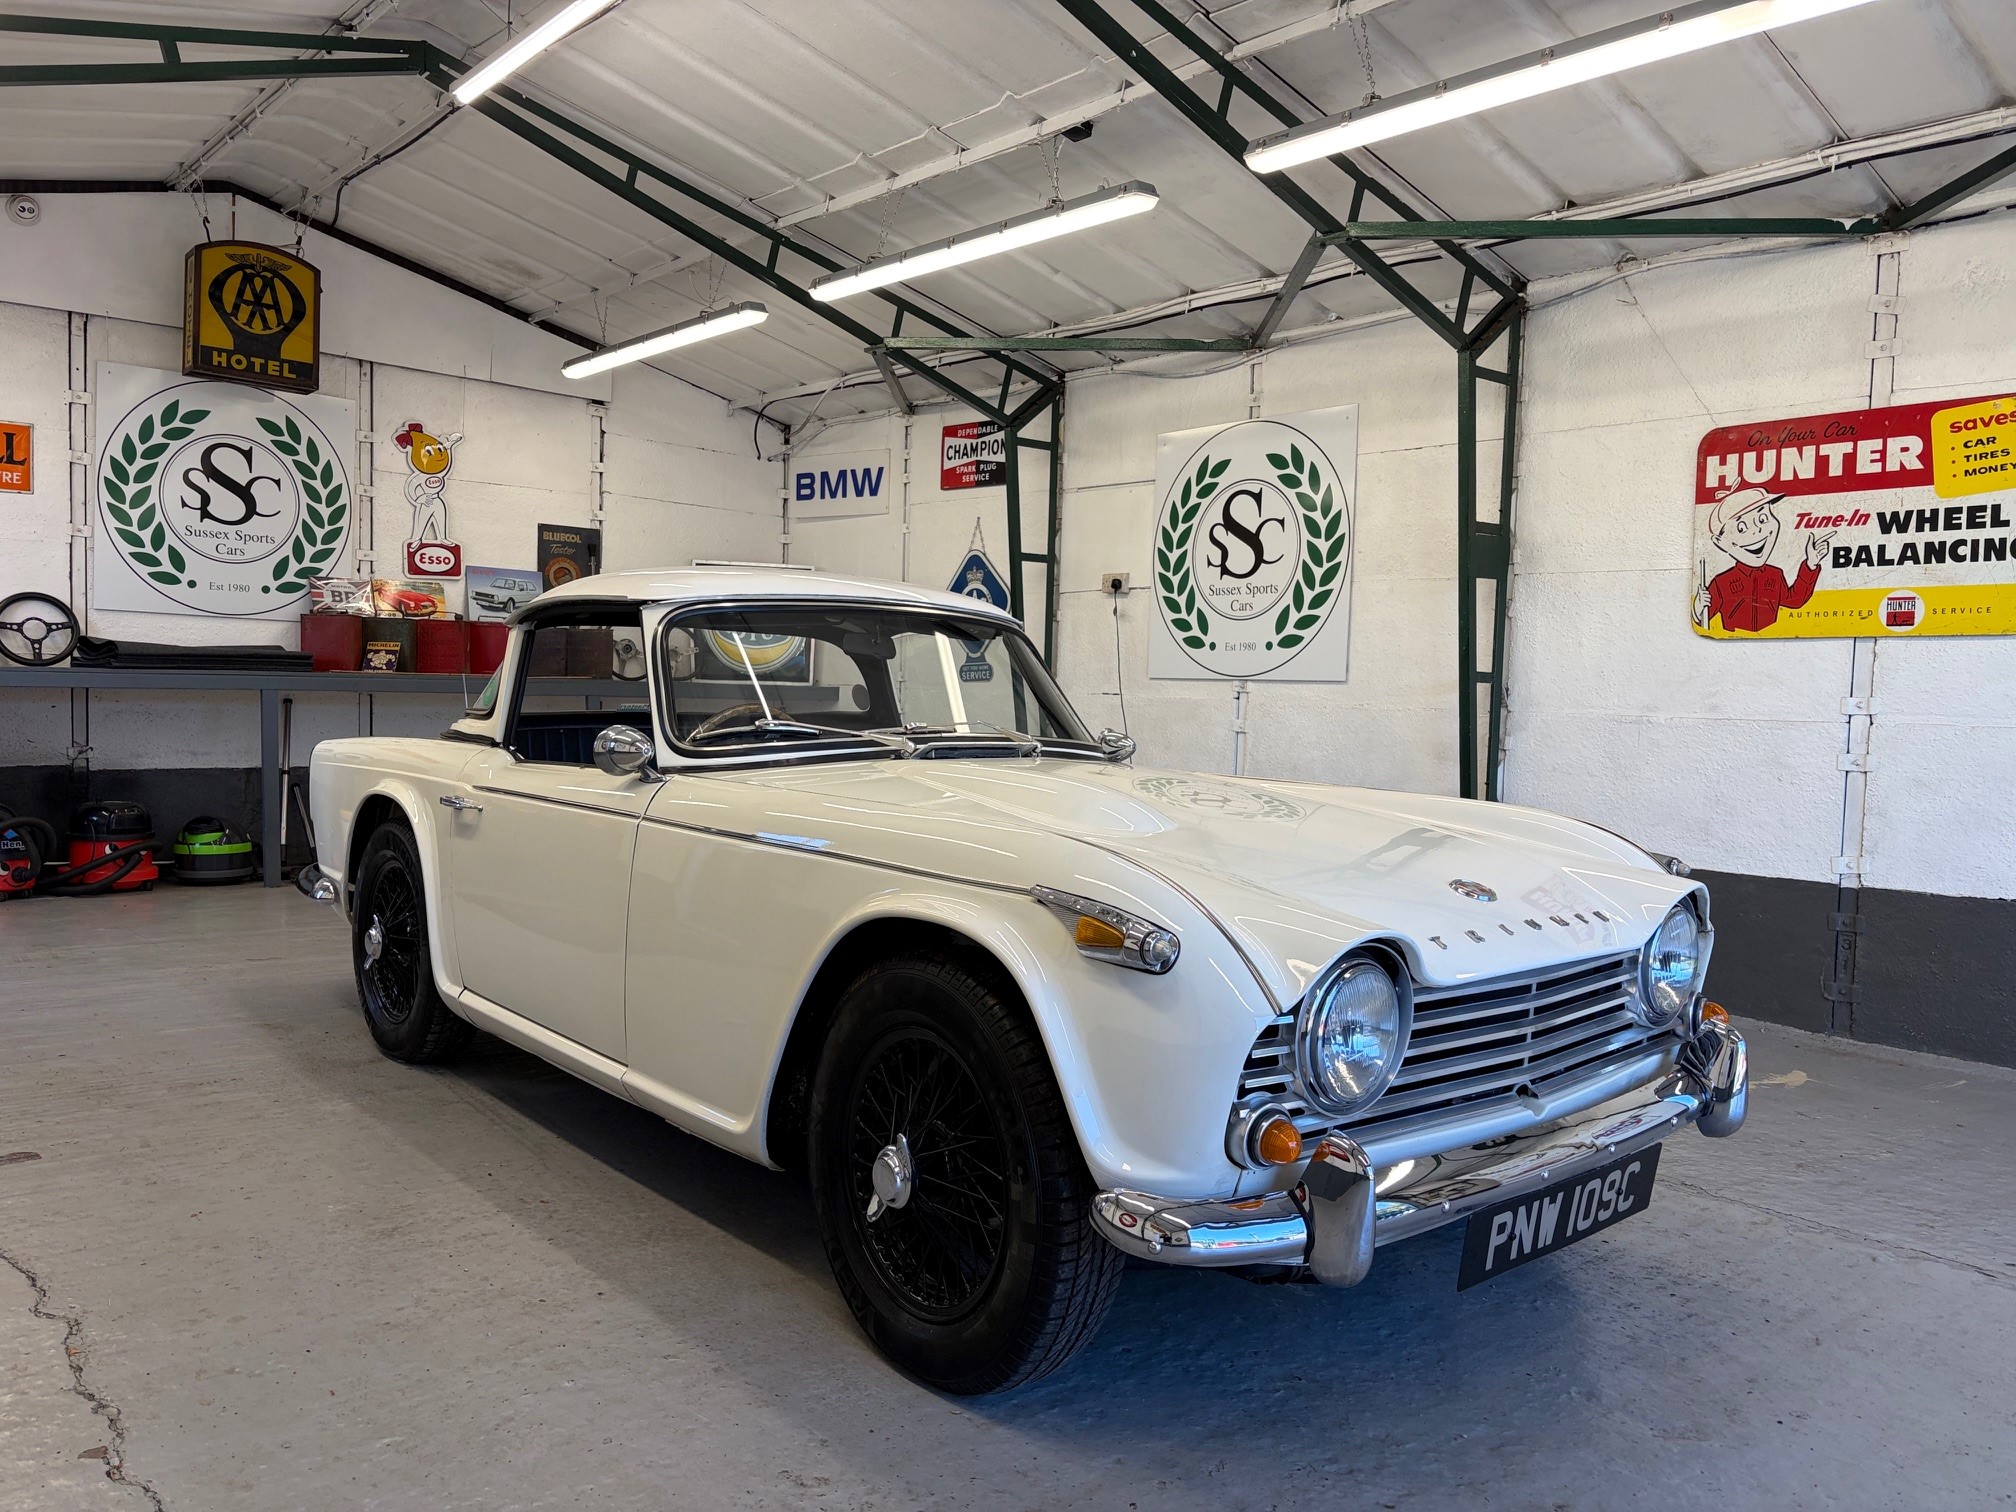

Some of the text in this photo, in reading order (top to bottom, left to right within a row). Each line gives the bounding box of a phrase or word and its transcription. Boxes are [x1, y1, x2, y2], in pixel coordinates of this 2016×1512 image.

[212, 350, 297, 379] HOTEL
[957, 424, 998, 437] DEPENDABLE
[1747, 421, 1858, 448] On Your Car
[1963, 436, 1997, 449] CAR
[1705, 435, 1924, 488] HUNTER
[1964, 448, 2011, 462] TIRES
[955, 462, 997, 474] SPARK PLUG
[1964, 462, 2016, 477] MONEY
[796, 466, 884, 502] BMW
[962, 473, 990, 482] SERVICE
[1793, 503, 2011, 535] Tune-In WHEEL
[184, 524, 276, 547] Sussex Sports
[542, 531, 582, 543] BLUECOL
[215, 542, 246, 557] Cars
[549, 543, 576, 555] Tester
[419, 552, 451, 566] Esso
[208, 581, 251, 593] Est 1980
[1208, 582, 1279, 599] Sussex Sports
[1230, 598, 1254, 612] Cars
[1789, 600, 1992, 619] AUTHORIZED HUNTER SERVICE
[1224, 641, 1257, 652] Est 1980
[961, 671, 990, 680] SERVICE
[1485, 1161, 1641, 1271] PNW 109C
